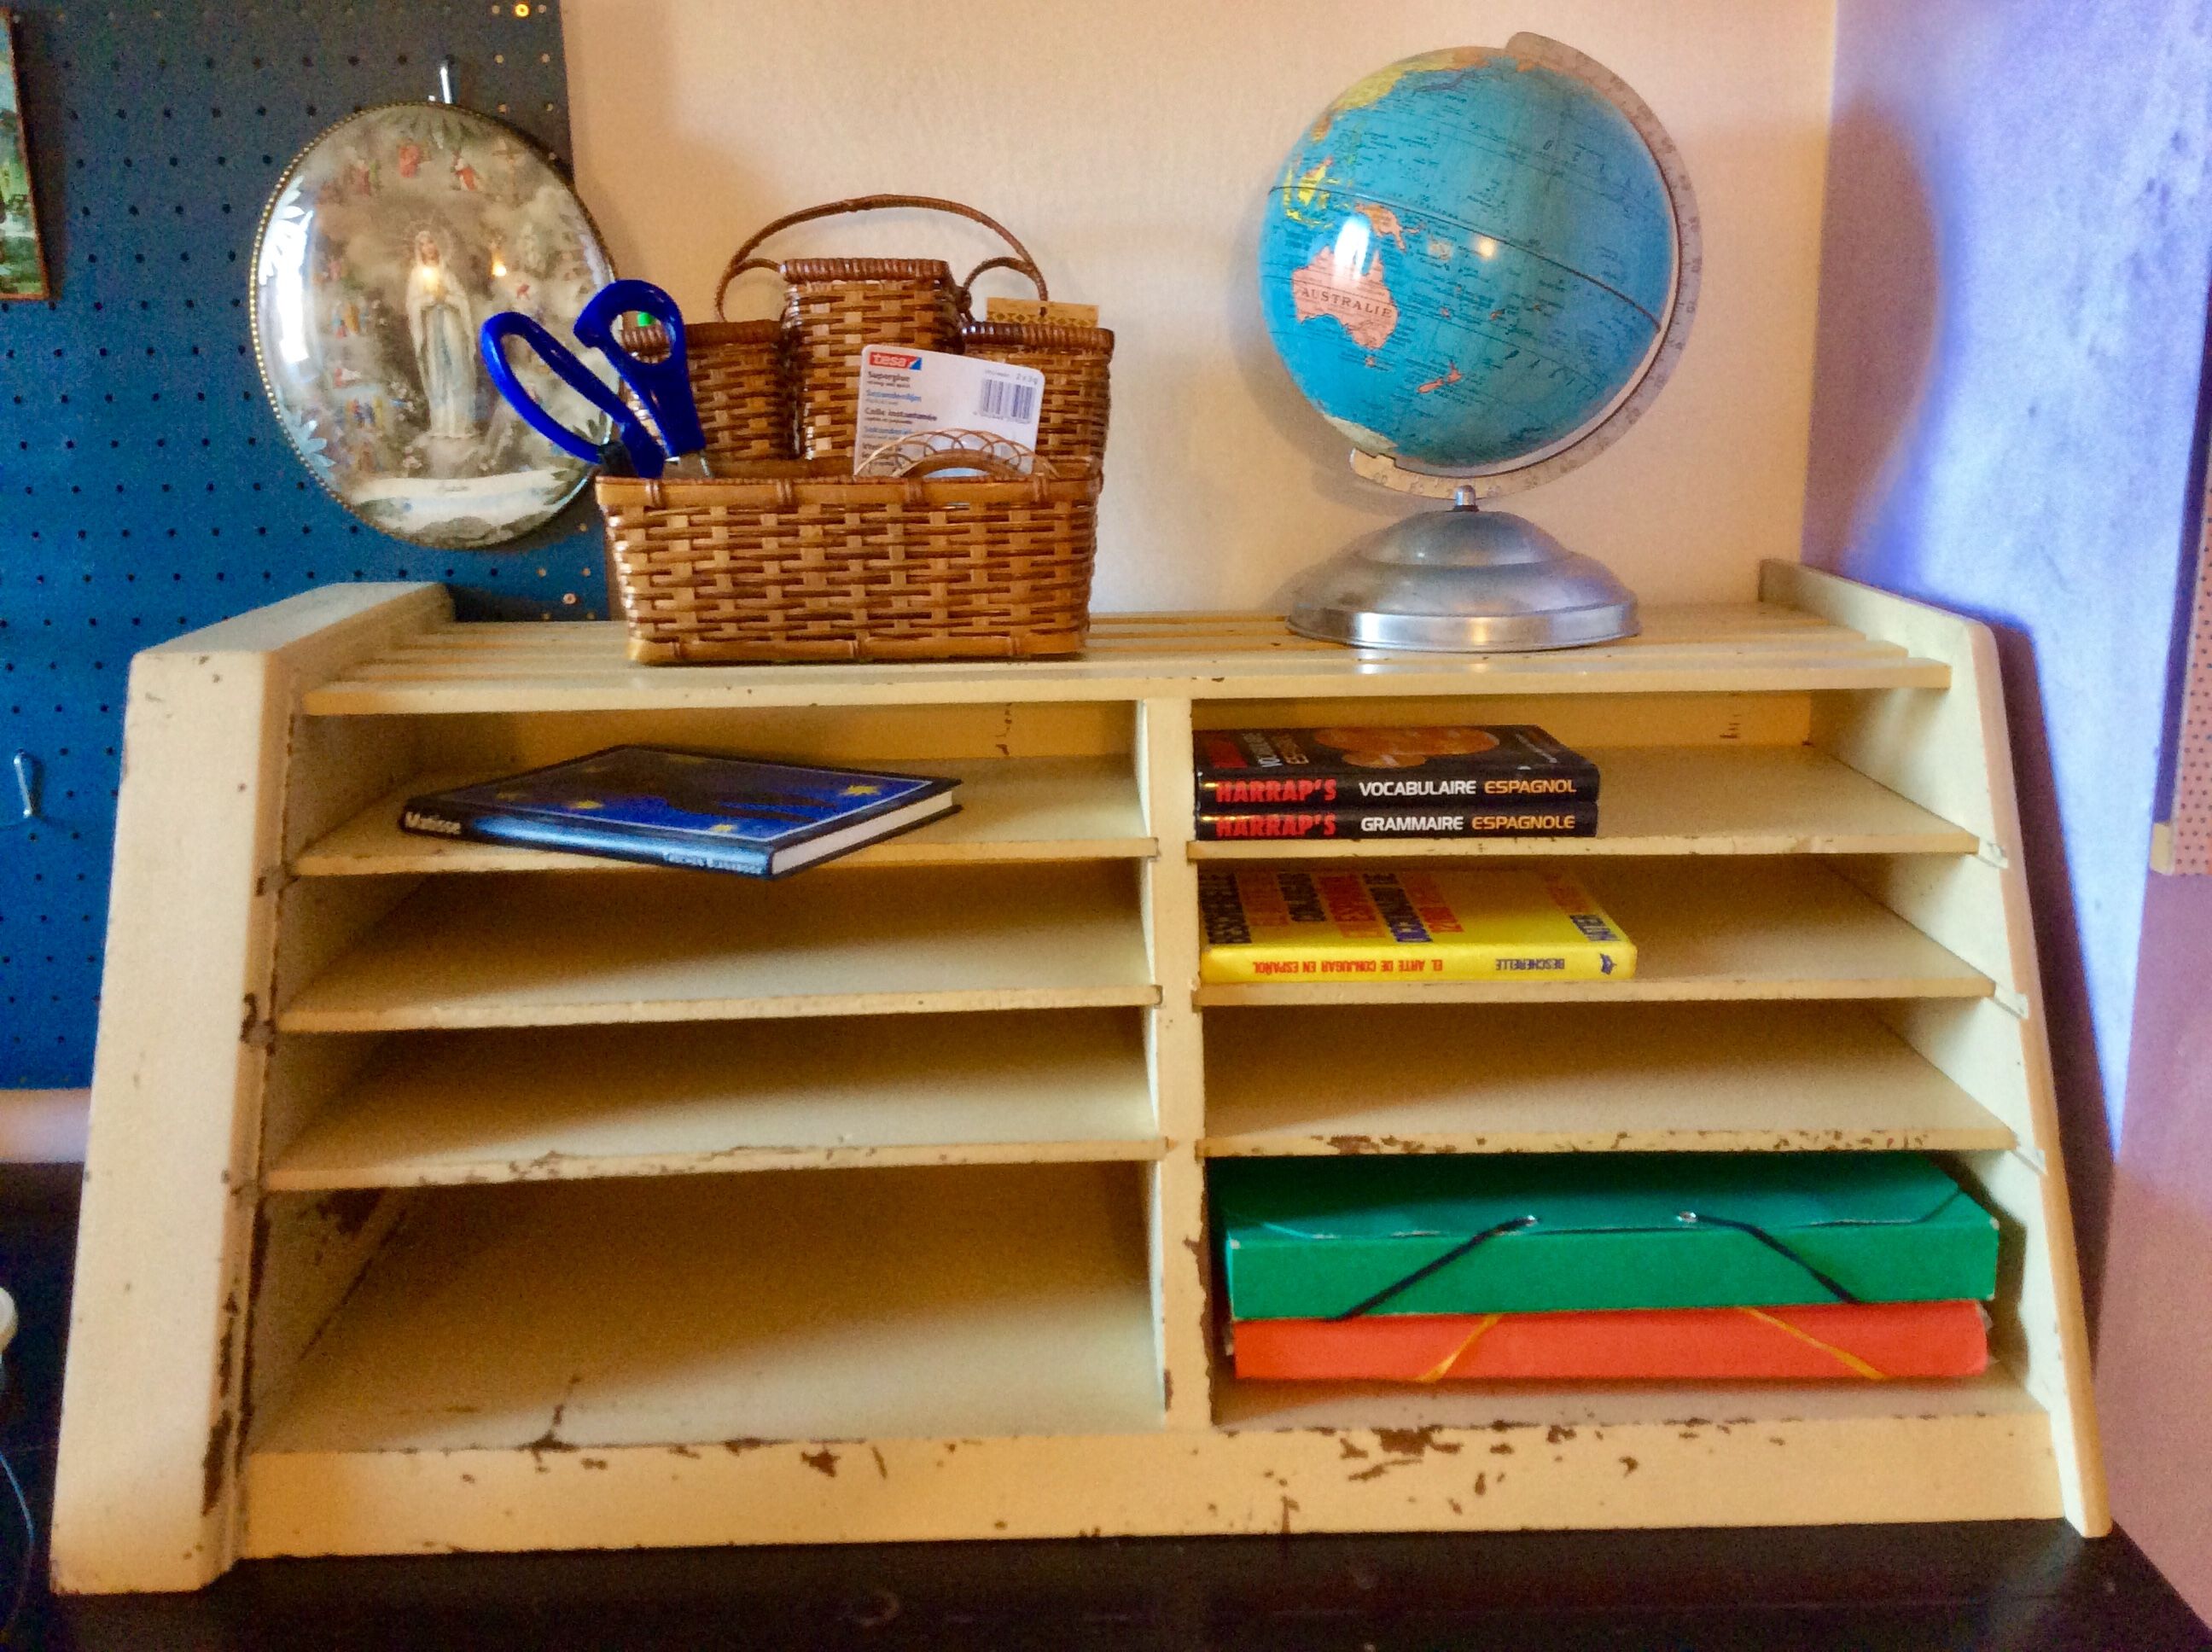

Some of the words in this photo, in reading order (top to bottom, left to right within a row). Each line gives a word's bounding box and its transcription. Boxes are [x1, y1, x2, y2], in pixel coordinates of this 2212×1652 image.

[1301, 288, 1394, 318] AUSTRALIE
[872, 353, 908, 368] tesa
[1214, 778, 1337, 803] HARRAP'S
[1359, 780, 1477, 797] VOCABULAIRE
[1484, 778, 1577, 794] ESPAGNOL
[1214, 813, 1337, 838] HARRAP'S
[1360, 816, 1464, 832] GRAMMAIRE
[1471, 815, 1576, 829] ESPAGNOLE
[1302, 961, 1317, 973] EN
[1321, 961, 1376, 973] CONJUGAR
[1382, 960, 1394, 972] DE
[1400, 960, 1427, 972] ARTE
[1432, 960, 1442, 971] EL
[1495, 958, 1565, 971] BESCHERELLE
